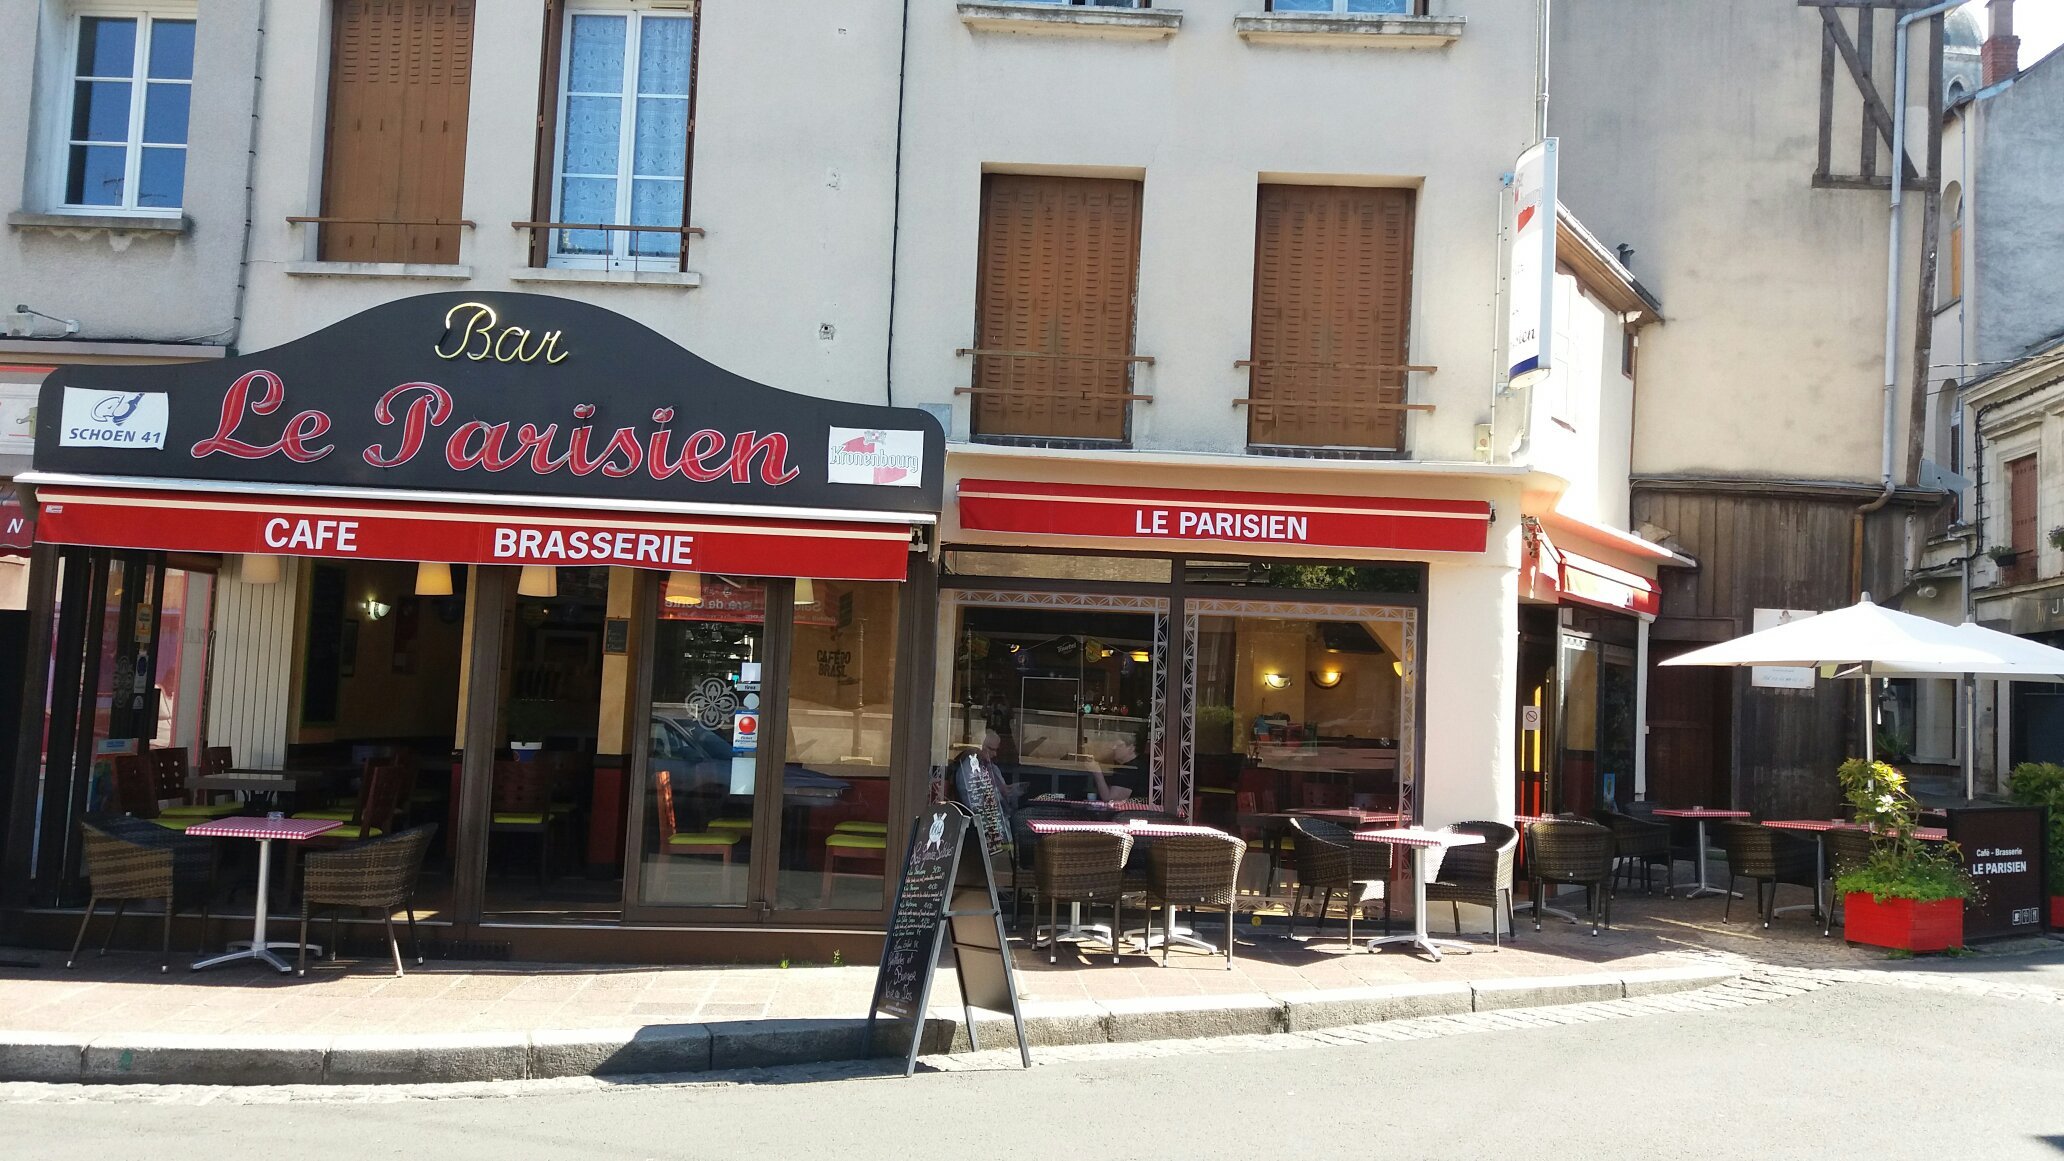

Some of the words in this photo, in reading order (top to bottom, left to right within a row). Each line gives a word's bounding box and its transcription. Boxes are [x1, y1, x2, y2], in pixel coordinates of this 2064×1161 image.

[435, 302, 569, 364] Bar
[68, 428, 136, 442] SCHOEN
[141, 431, 161, 444] 41
[191, 369, 335, 464] Le
[362, 382, 800, 487] Parisien
[829, 445, 919, 474] Kronenbourg
[1135, 509, 1169, 534] LE
[1178, 511, 1308, 541] PARISIEN
[264, 517, 359, 552] CAFE
[494, 527, 694, 565] BRASSERIE
[1976, 849, 1990, 857] Café
[1995, 847, 2023, 857] Brasserie
[1972, 863, 1984, 875] LE
[1985, 861, 2027, 874] PARISIEN
